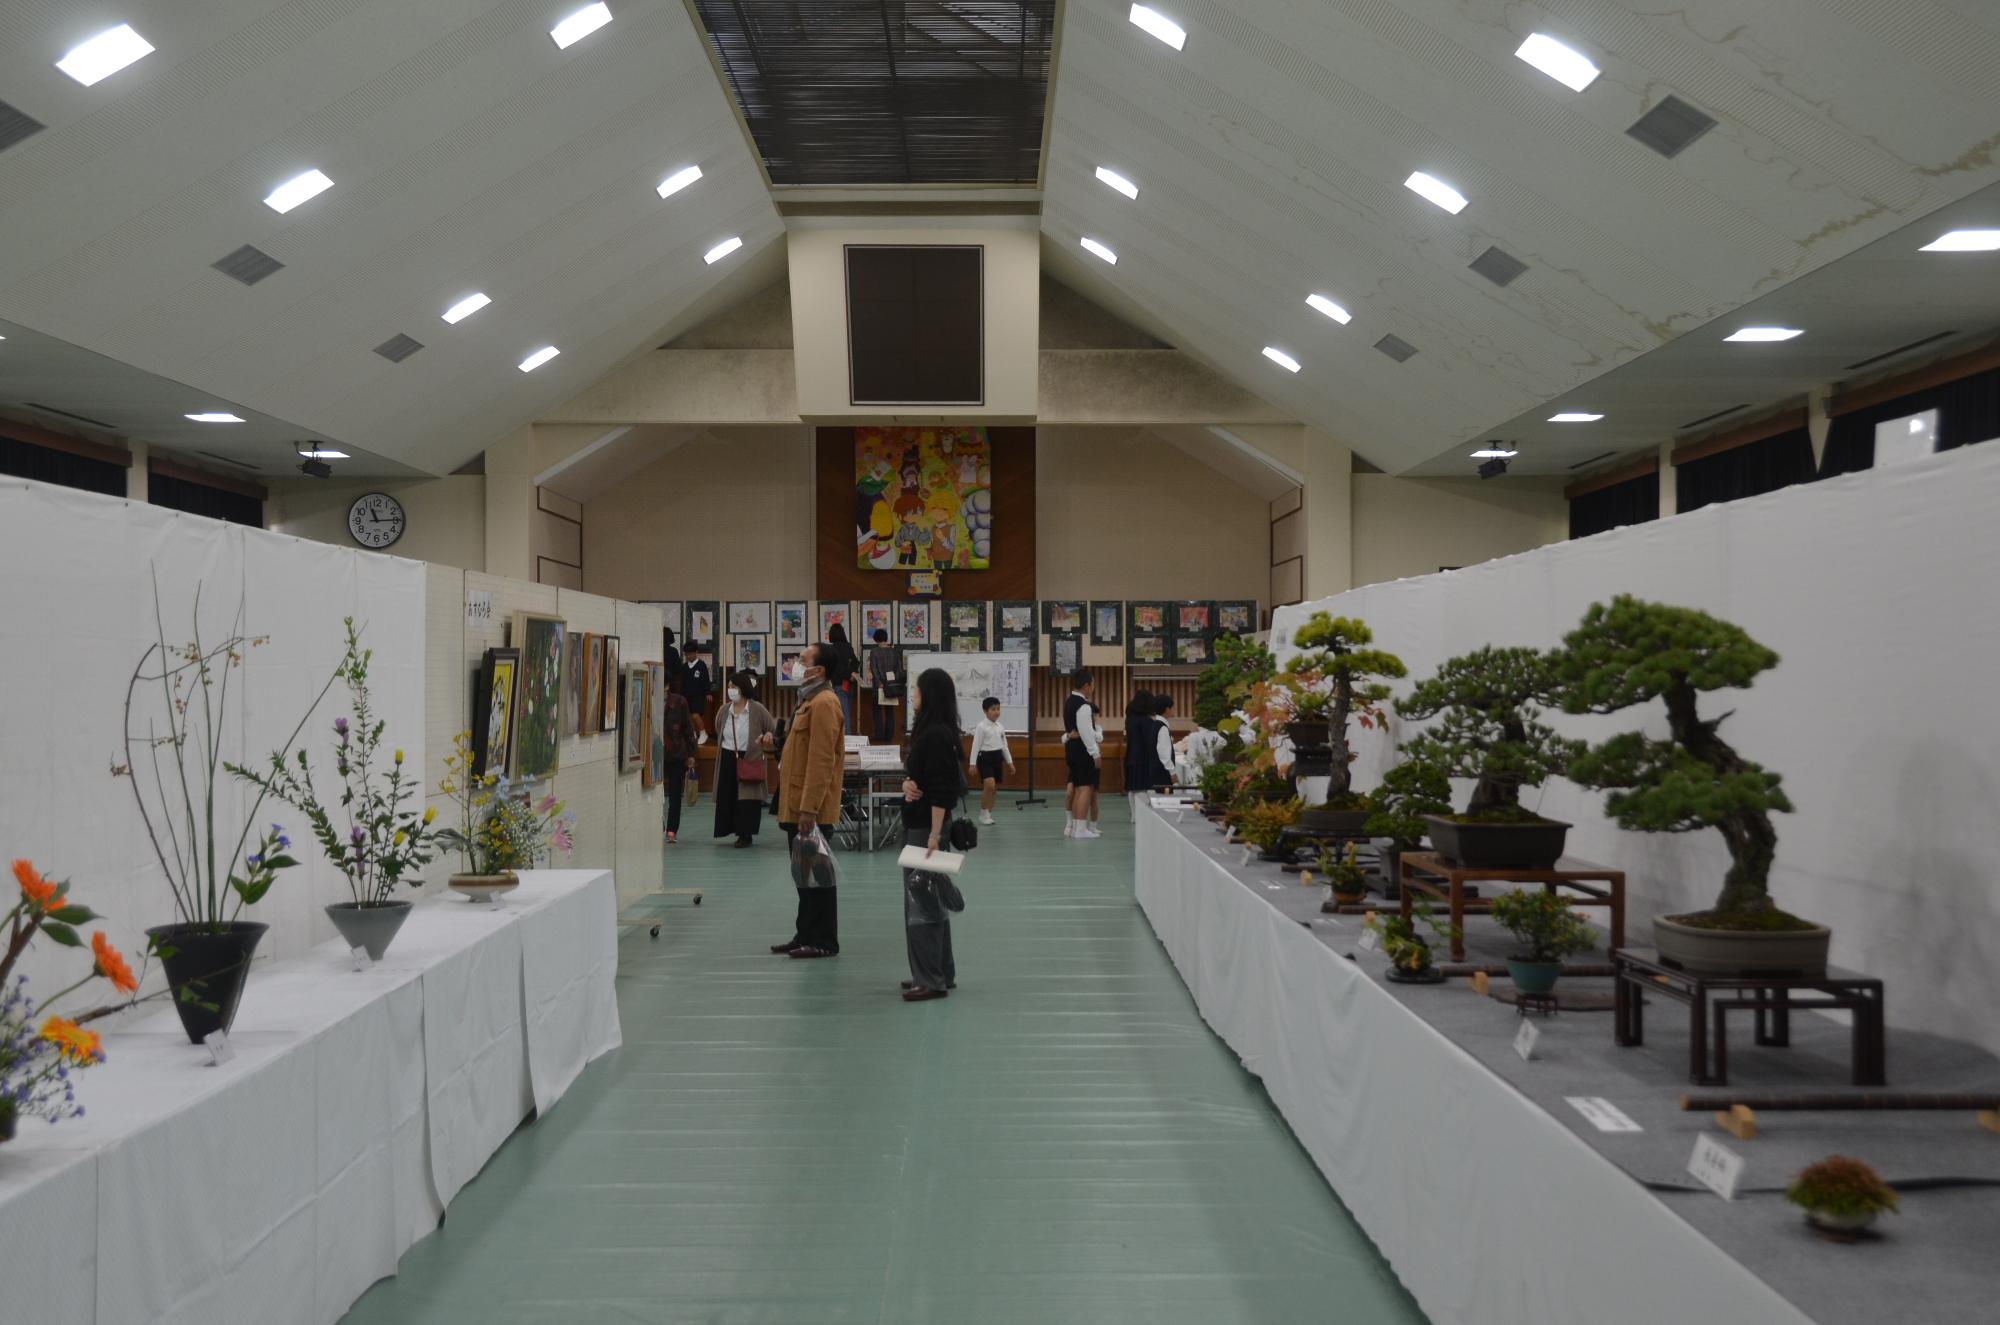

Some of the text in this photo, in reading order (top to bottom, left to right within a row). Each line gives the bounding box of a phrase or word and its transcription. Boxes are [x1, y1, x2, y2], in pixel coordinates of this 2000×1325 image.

[356, 508, 366, 516] 10
[390, 506, 396, 516] 2
[355, 517, 360, 525] 9
[358, 526, 364, 534] 8
[374, 534, 380, 542] 6
[384, 532, 389, 540] 5
